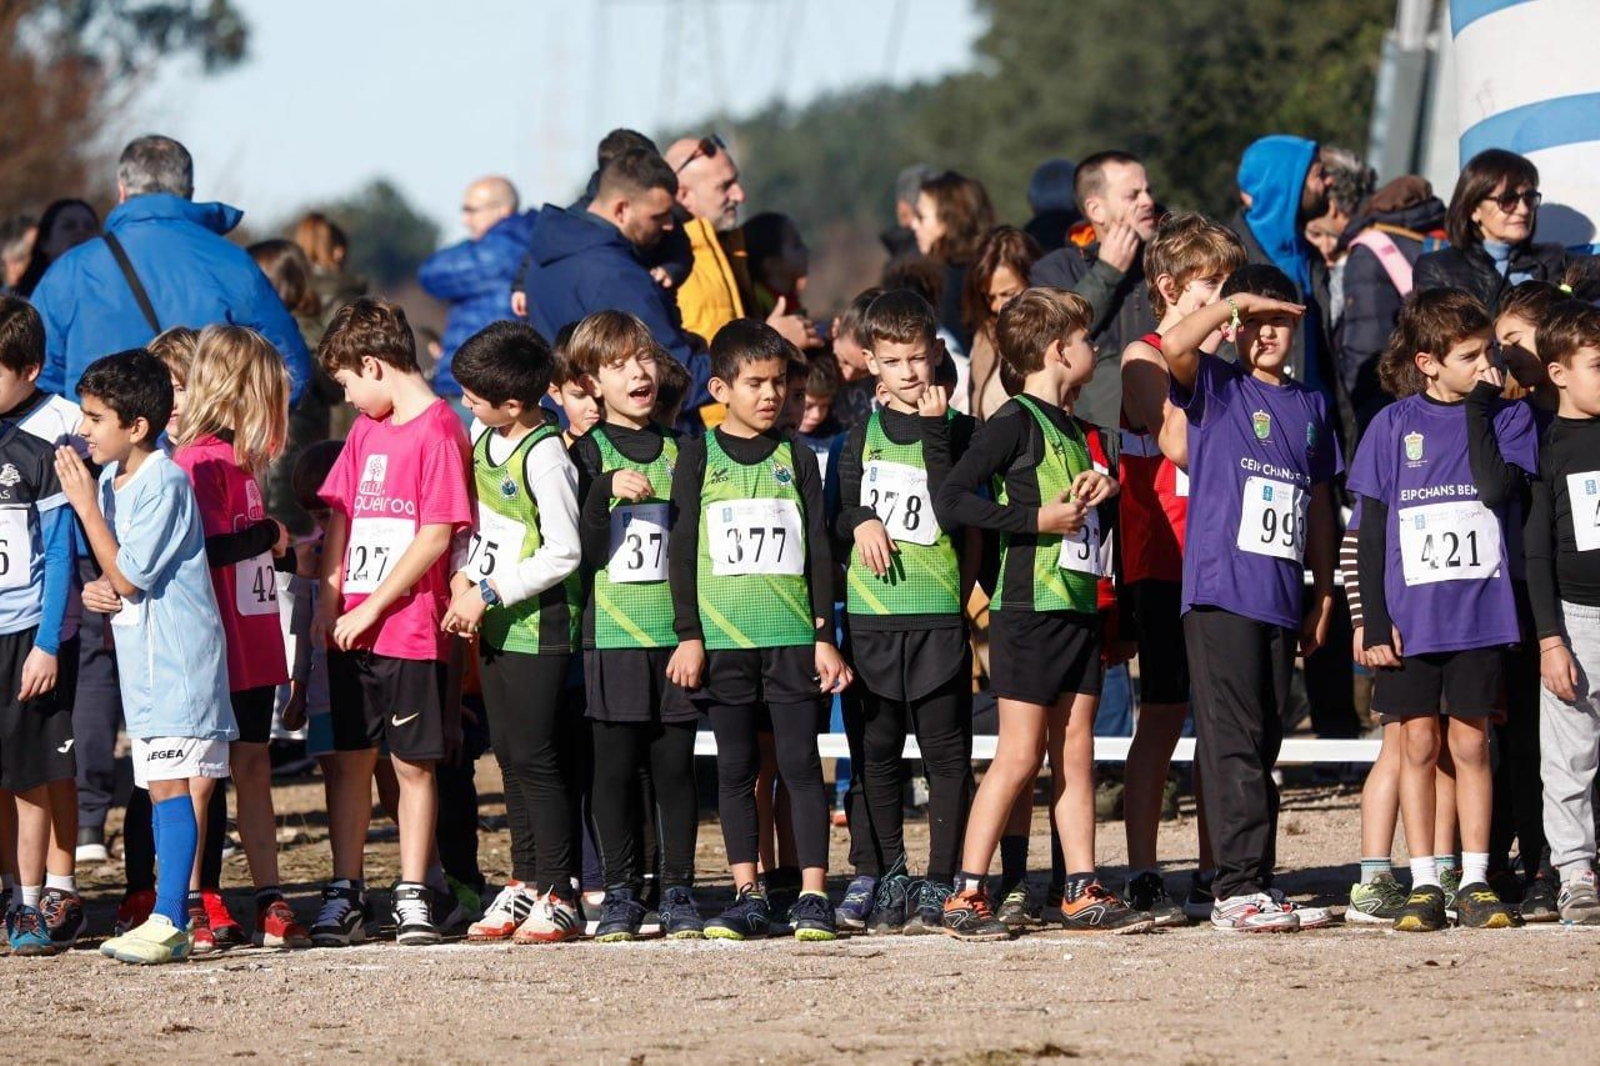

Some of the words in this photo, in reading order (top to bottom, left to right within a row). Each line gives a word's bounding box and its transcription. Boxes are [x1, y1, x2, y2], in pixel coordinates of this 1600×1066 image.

[870, 488, 922, 531] 378
[1399, 489, 1417, 501] EIP
[1418, 485, 1456, 500] CHANS
[468, 532, 499, 576] 75
[627, 533, 670, 570] 37
[726, 527, 786, 564] 377
[1421, 530, 1481, 570] 421
[252, 565, 276, 603] 42
